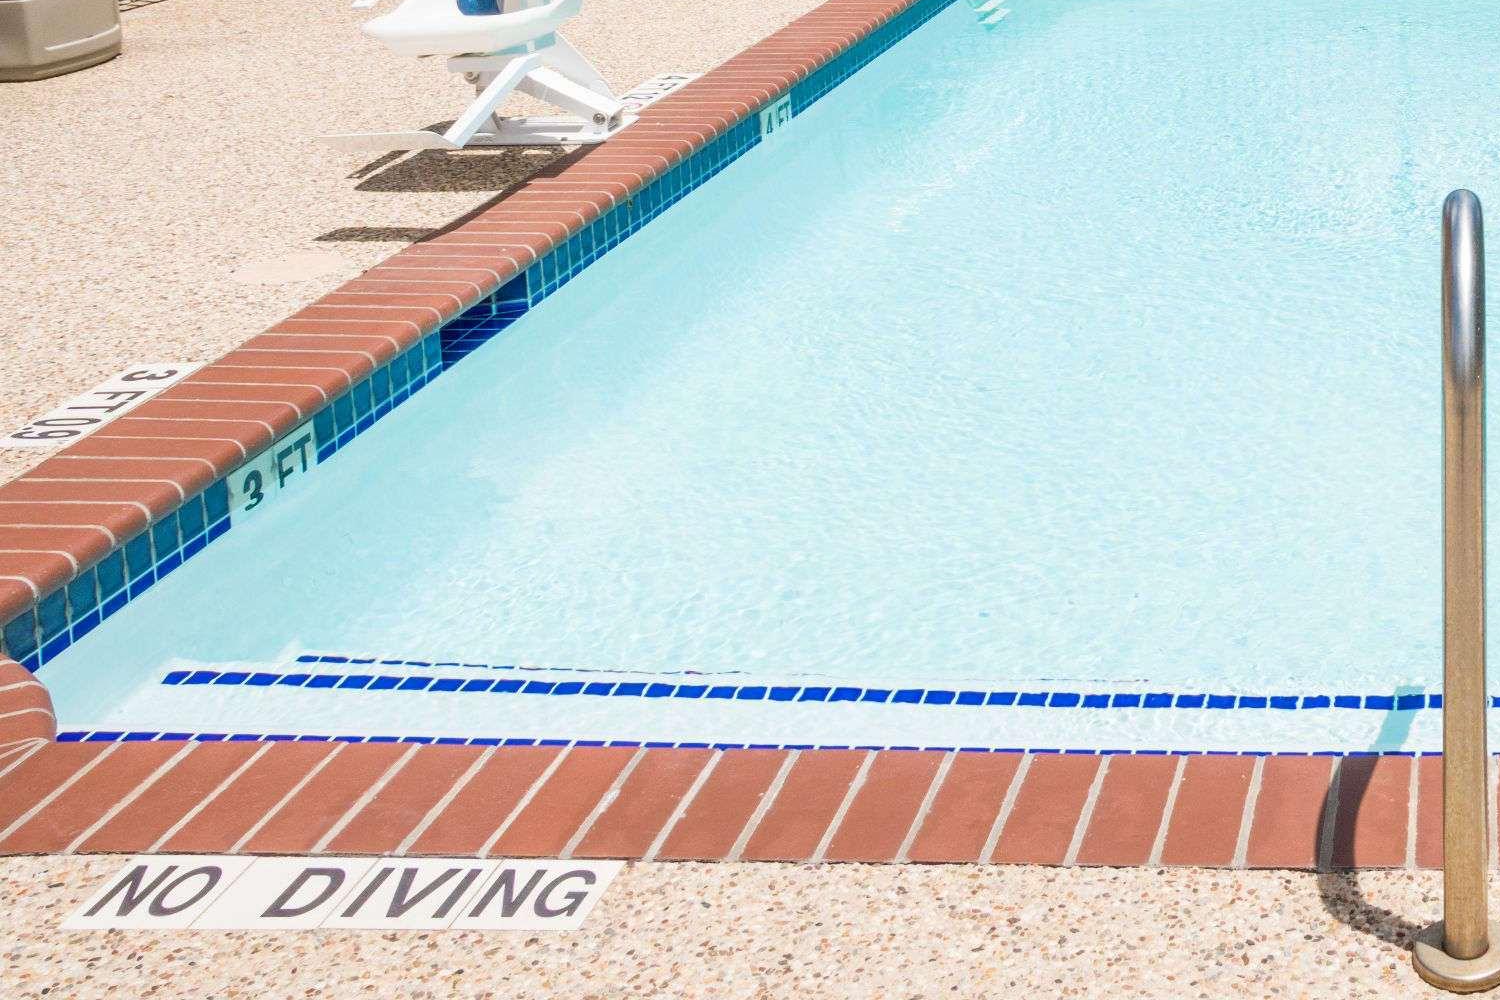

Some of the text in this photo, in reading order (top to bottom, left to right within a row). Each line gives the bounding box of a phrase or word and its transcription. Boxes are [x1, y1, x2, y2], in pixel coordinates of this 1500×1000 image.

[778, 101, 790, 127] FT
[10, 369, 178, 439] 3 FT 0.9
[243, 432, 313, 511] 3 FT
[83, 865, 598, 918] NO DIVING
